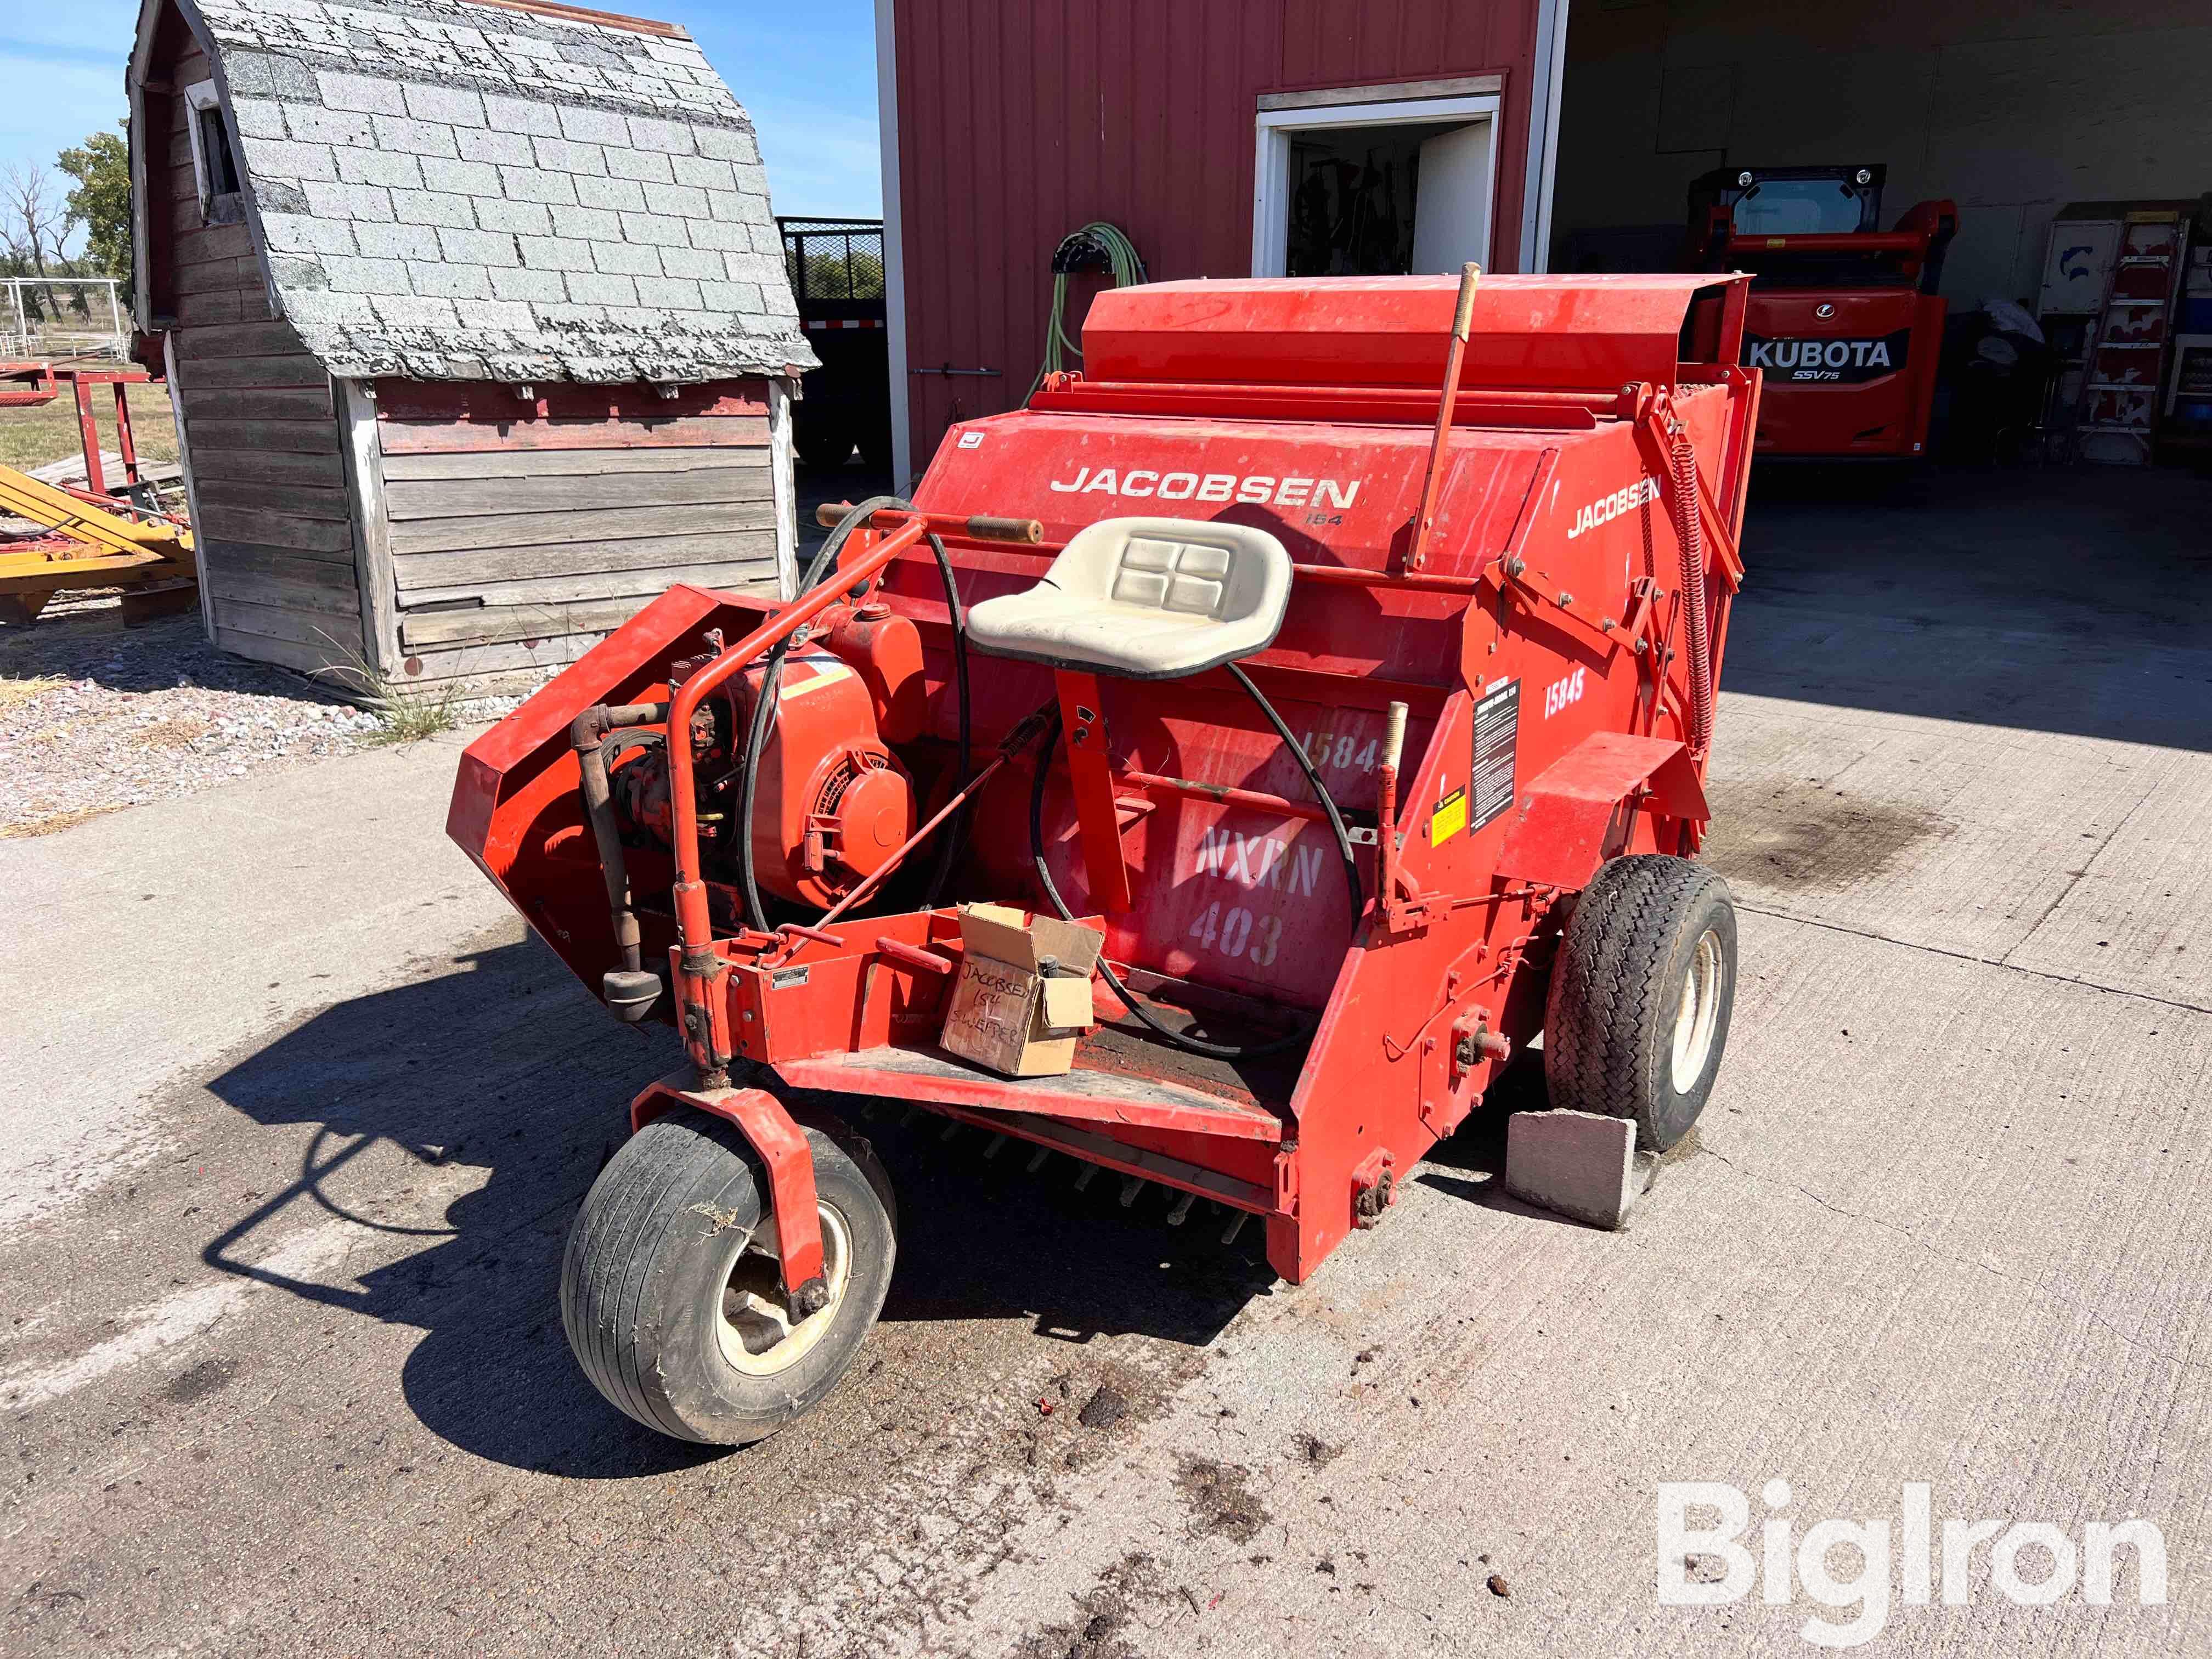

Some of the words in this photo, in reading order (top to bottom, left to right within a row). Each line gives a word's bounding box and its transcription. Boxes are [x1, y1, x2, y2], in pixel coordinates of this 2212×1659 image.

[1750, 341, 1891, 368] KUBOTA
[1792, 370, 1840, 380] SSV75
[1050, 467, 1361, 509] JACOBSEN
[1567, 474, 1661, 539] JACOBSEN
[1544, 667, 1585, 720] 15845
[1300, 732, 1381, 776] 1584
[1195, 826, 1323, 897] NXRN
[1189, 900, 1282, 966] 403
